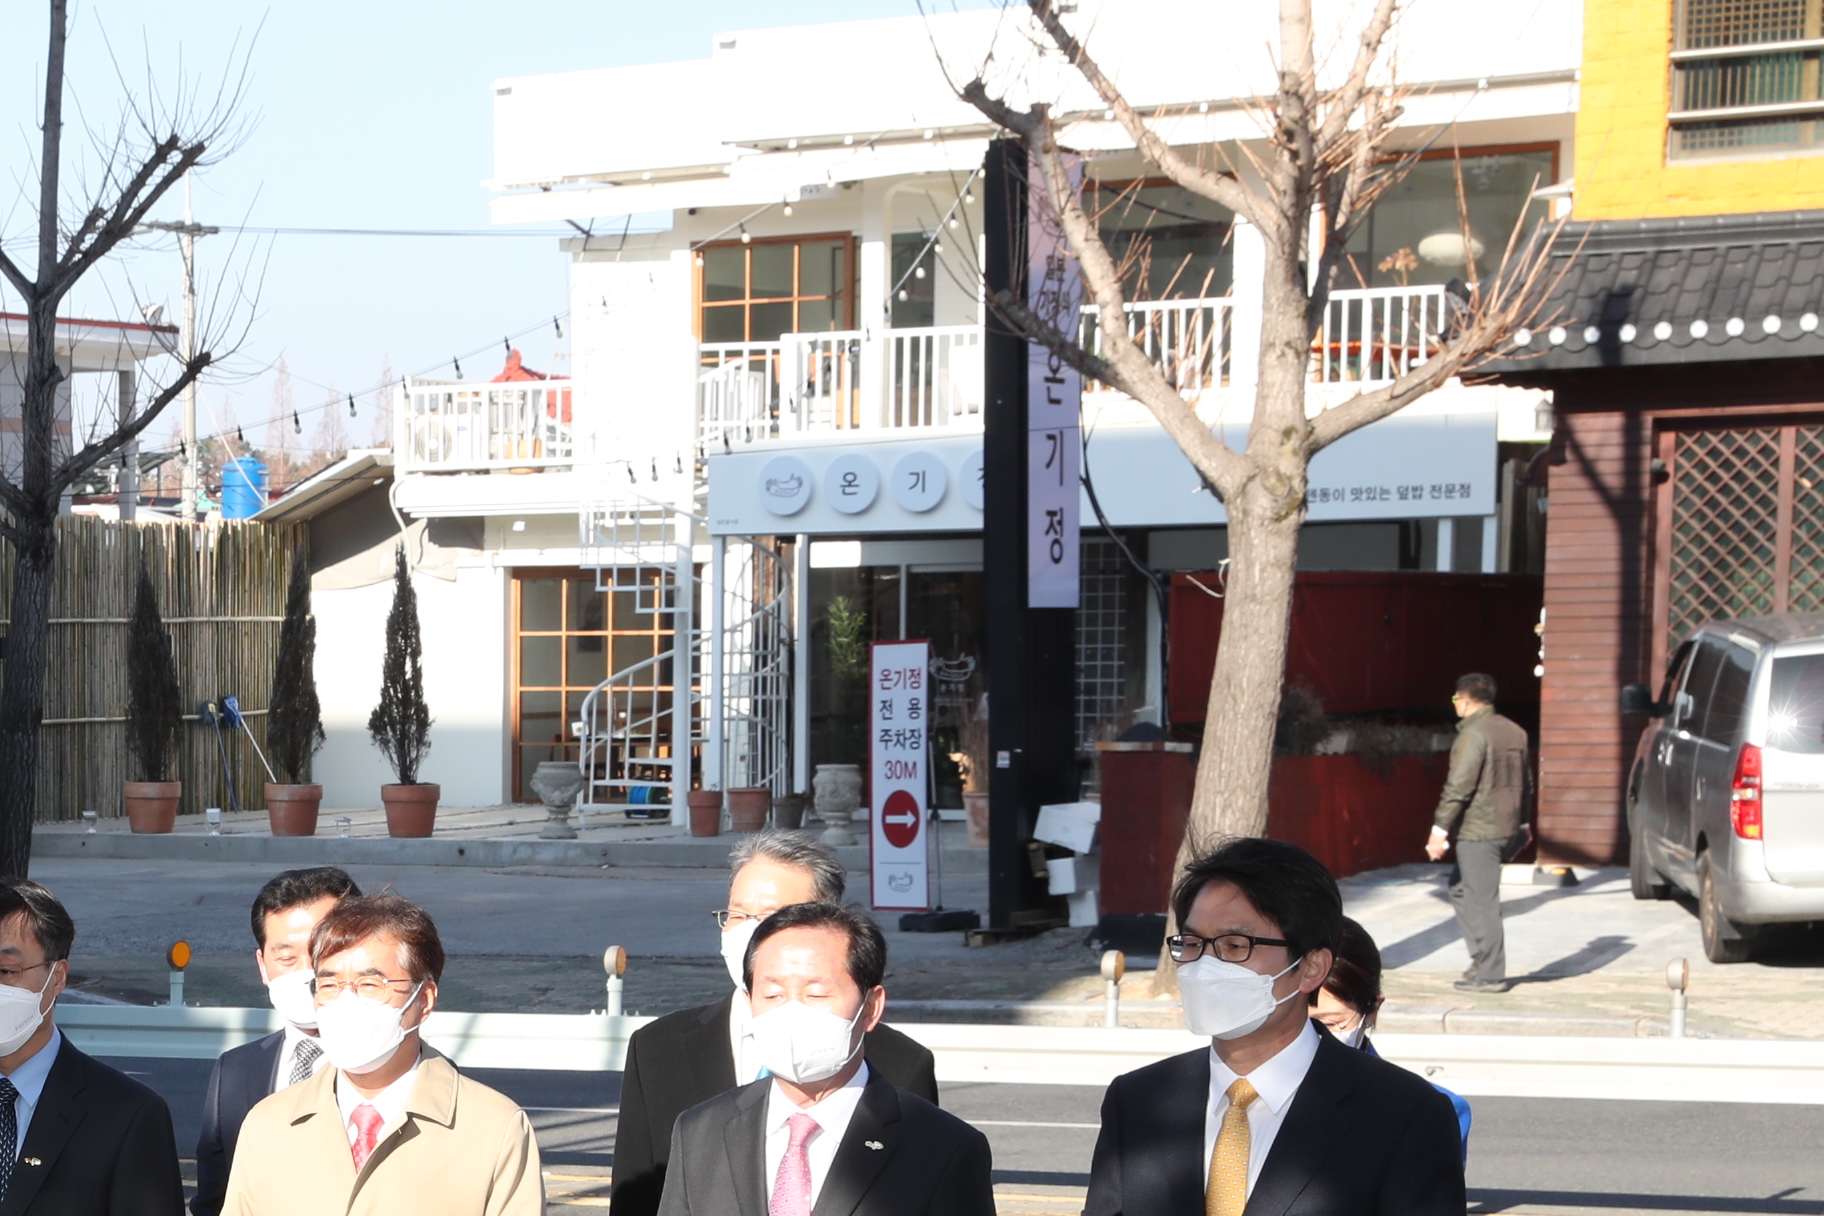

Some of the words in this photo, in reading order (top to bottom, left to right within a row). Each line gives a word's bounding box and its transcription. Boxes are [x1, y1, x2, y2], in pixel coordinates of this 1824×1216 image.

[1350, 485, 1391, 502] 맛있는
[1396, 483, 1425, 501] 덮밥
[1429, 482, 1472, 500] 전문점
[879, 667, 922, 691] 온기정
[879, 727, 922, 751] 주차장
[884, 760, 918, 780] 30M
